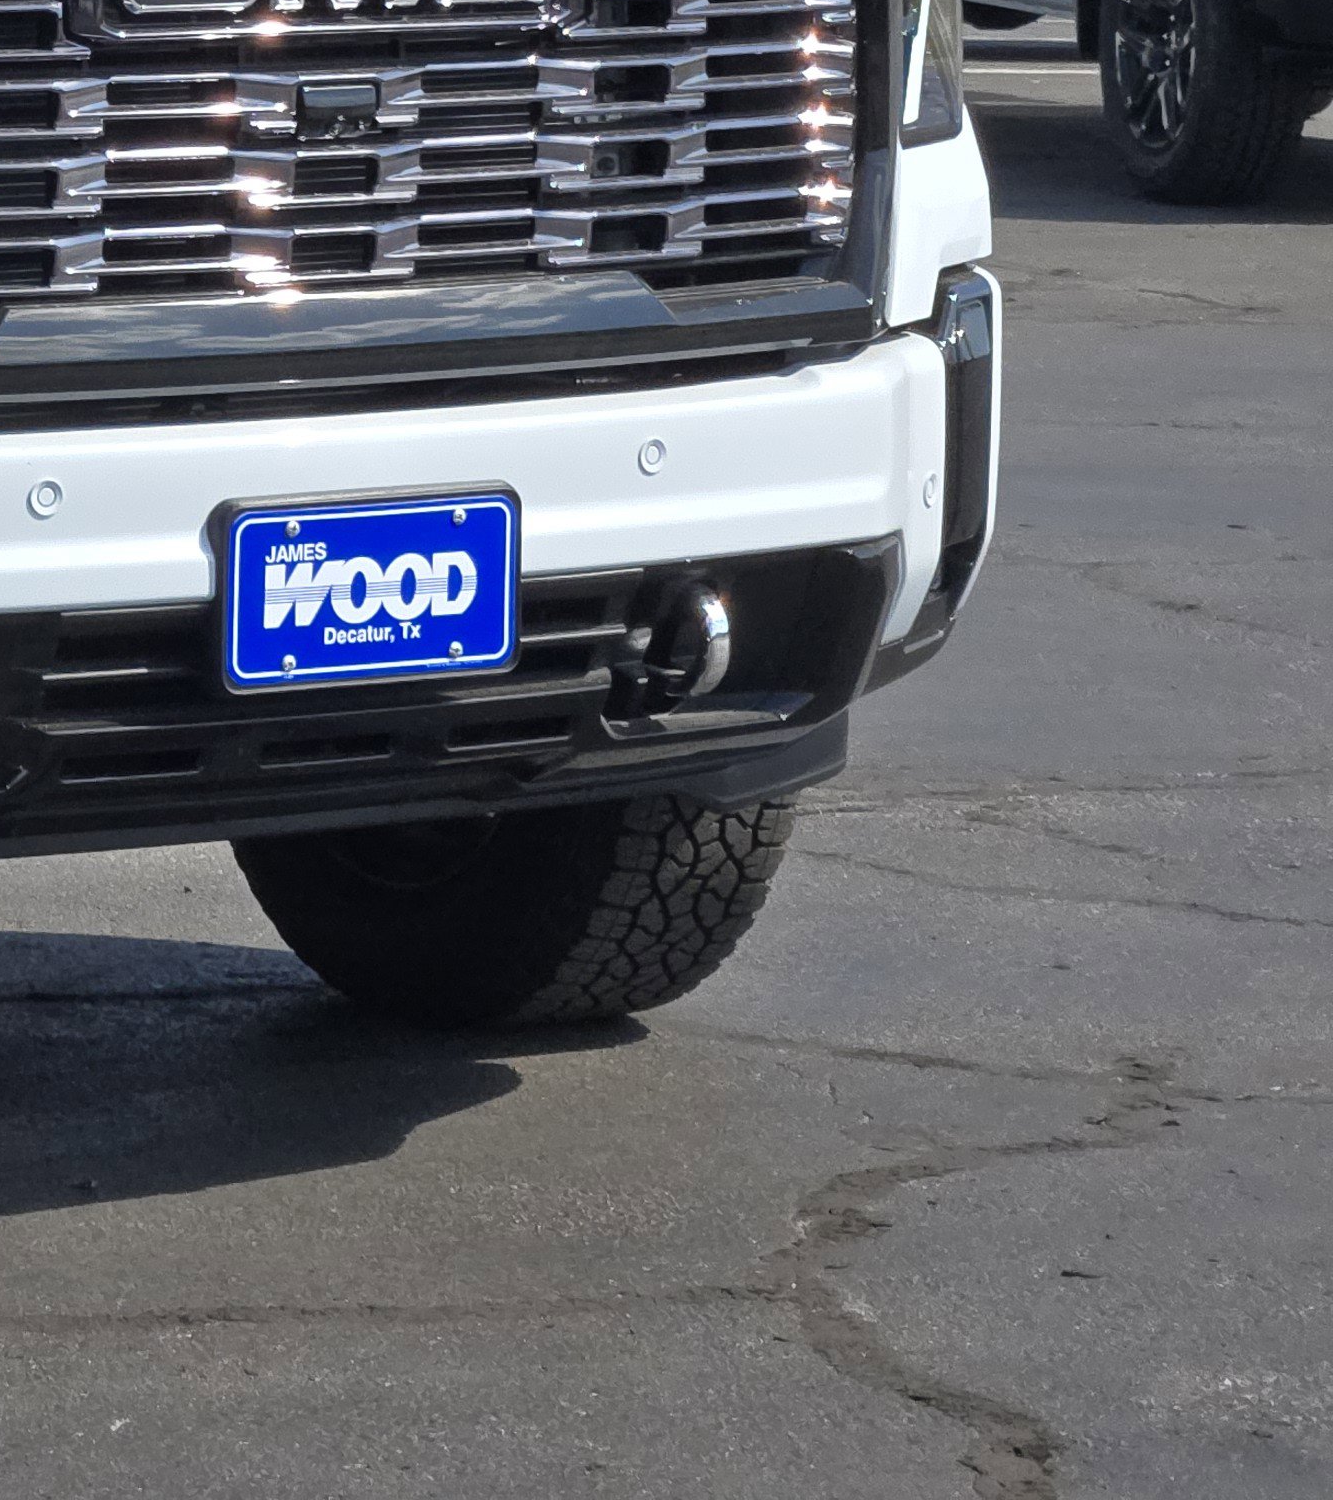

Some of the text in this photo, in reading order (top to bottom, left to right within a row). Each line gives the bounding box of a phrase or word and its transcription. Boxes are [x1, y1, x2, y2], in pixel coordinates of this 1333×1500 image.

[264, 542, 328, 564] JAMES
[263, 551, 478, 629] WOOD
[323, 621, 421, 645] Decatur, Tx
